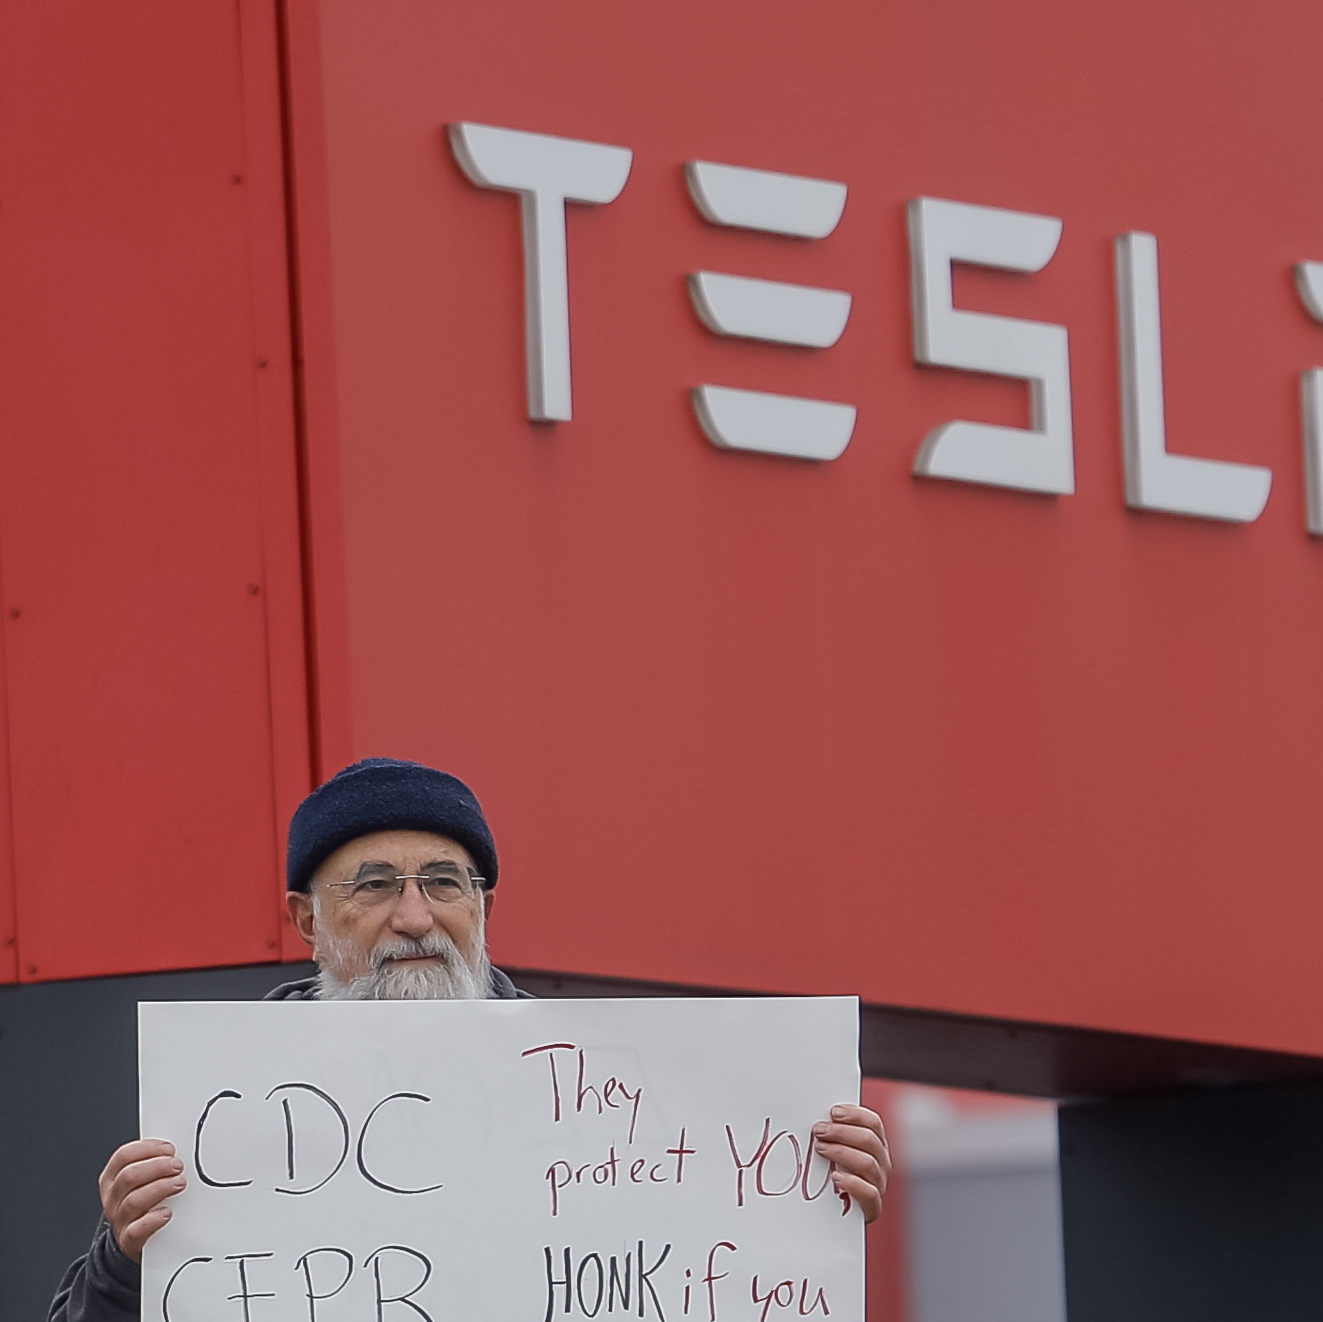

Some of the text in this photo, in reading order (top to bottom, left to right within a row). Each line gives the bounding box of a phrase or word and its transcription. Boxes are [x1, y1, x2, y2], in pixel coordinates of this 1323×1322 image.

[194, 1083, 443, 1195] CDC
[521, 1043, 643, 1145] They
[545, 1126, 696, 1217] protect
[683, 1241, 738, 1322] if
